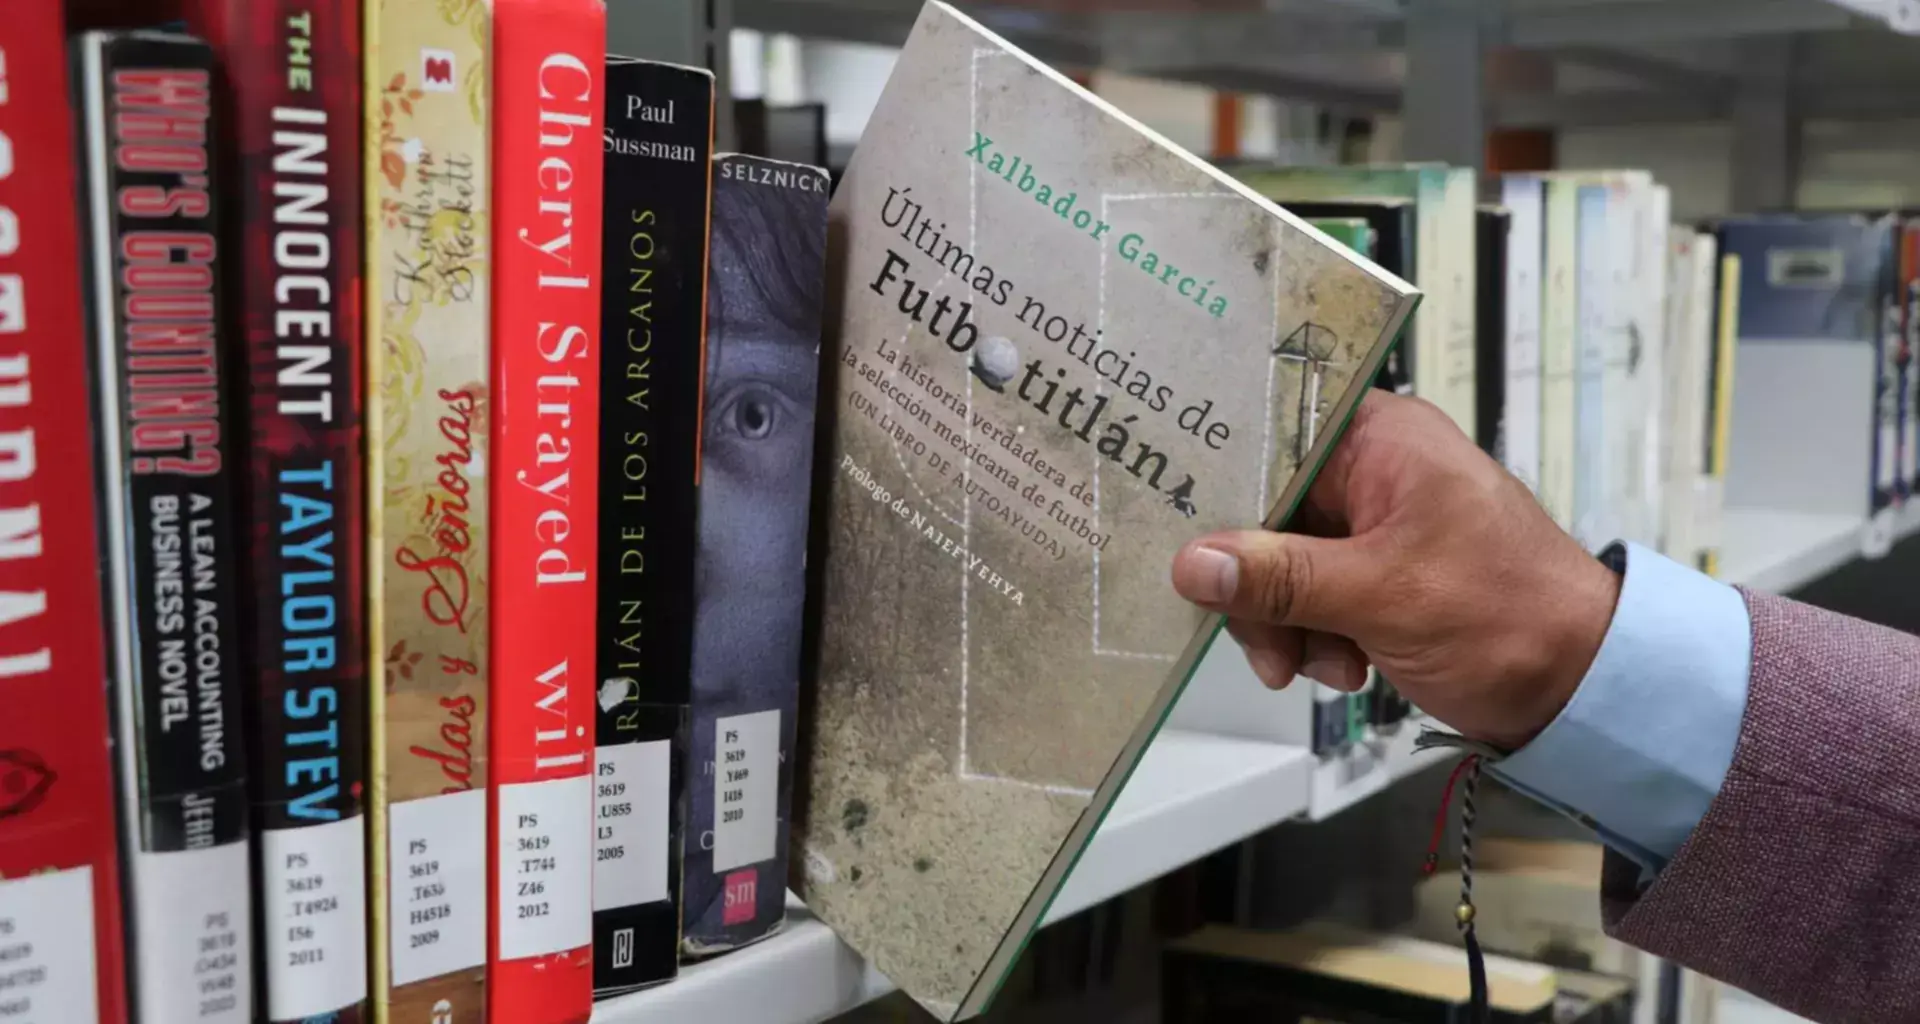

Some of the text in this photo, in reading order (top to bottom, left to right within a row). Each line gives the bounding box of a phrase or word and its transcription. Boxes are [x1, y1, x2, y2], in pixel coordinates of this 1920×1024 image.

[625, 96, 675, 125] Paul
[602, 129, 696, 163] Sussman
[722, 162, 824, 193] SELZNICK
[271, 11, 332, 422] THE INNOCENT
[965, 131, 1230, 319] Xalbador García
[114, 70, 221, 475] WHO'S COUNTING?
[517, 53, 593, 588] Cheryl Strayed
[880, 185, 1230, 450] Últimas noticias de
[869, 249, 1172, 492] Futbtitlán
[876, 339, 1095, 508] La historia verdadera de
[841, 345, 1111, 552] la selección mexicana de futbol
[616, 209, 655, 744] RDIÁN DE LOS ARCANOS
[848, 390, 1066, 562] (UN LIBRO DE AUTOAYUDA)
[396, 388, 476, 634] Señoras
[840, 453, 1025, 607] Prólogo de NAIEF YEHYA
[279, 459, 336, 674] TAYLOR
[150, 495, 190, 733] BUSINESS NOVEL
[188, 492, 226, 771] A LEAN ACCOUNTING
[438, 655, 478, 674] y
[726, 730, 738, 744] PS
[725, 749, 746, 763] 3619
[599, 763, 615, 776] PS
[598, 783, 625, 797] 3619
[518, 814, 538, 828] PS
[598, 803, 631, 819] .U855
[518, 836, 549, 850] 3619
[598, 826, 613, 840] L3
[409, 839, 427, 855] PS
[597, 846, 624, 860] 2005
[286, 853, 308, 869] PS
[409, 861, 439, 878] 3619
[518, 857, 556, 873] .T744
[286, 877, 322, 893] 3619
[518, 881, 544, 896] Z46
[724, 880, 755, 907] sm
[518, 903, 549, 919] 2012
[410, 930, 439, 948] 2009
[289, 949, 323, 966] 2011
